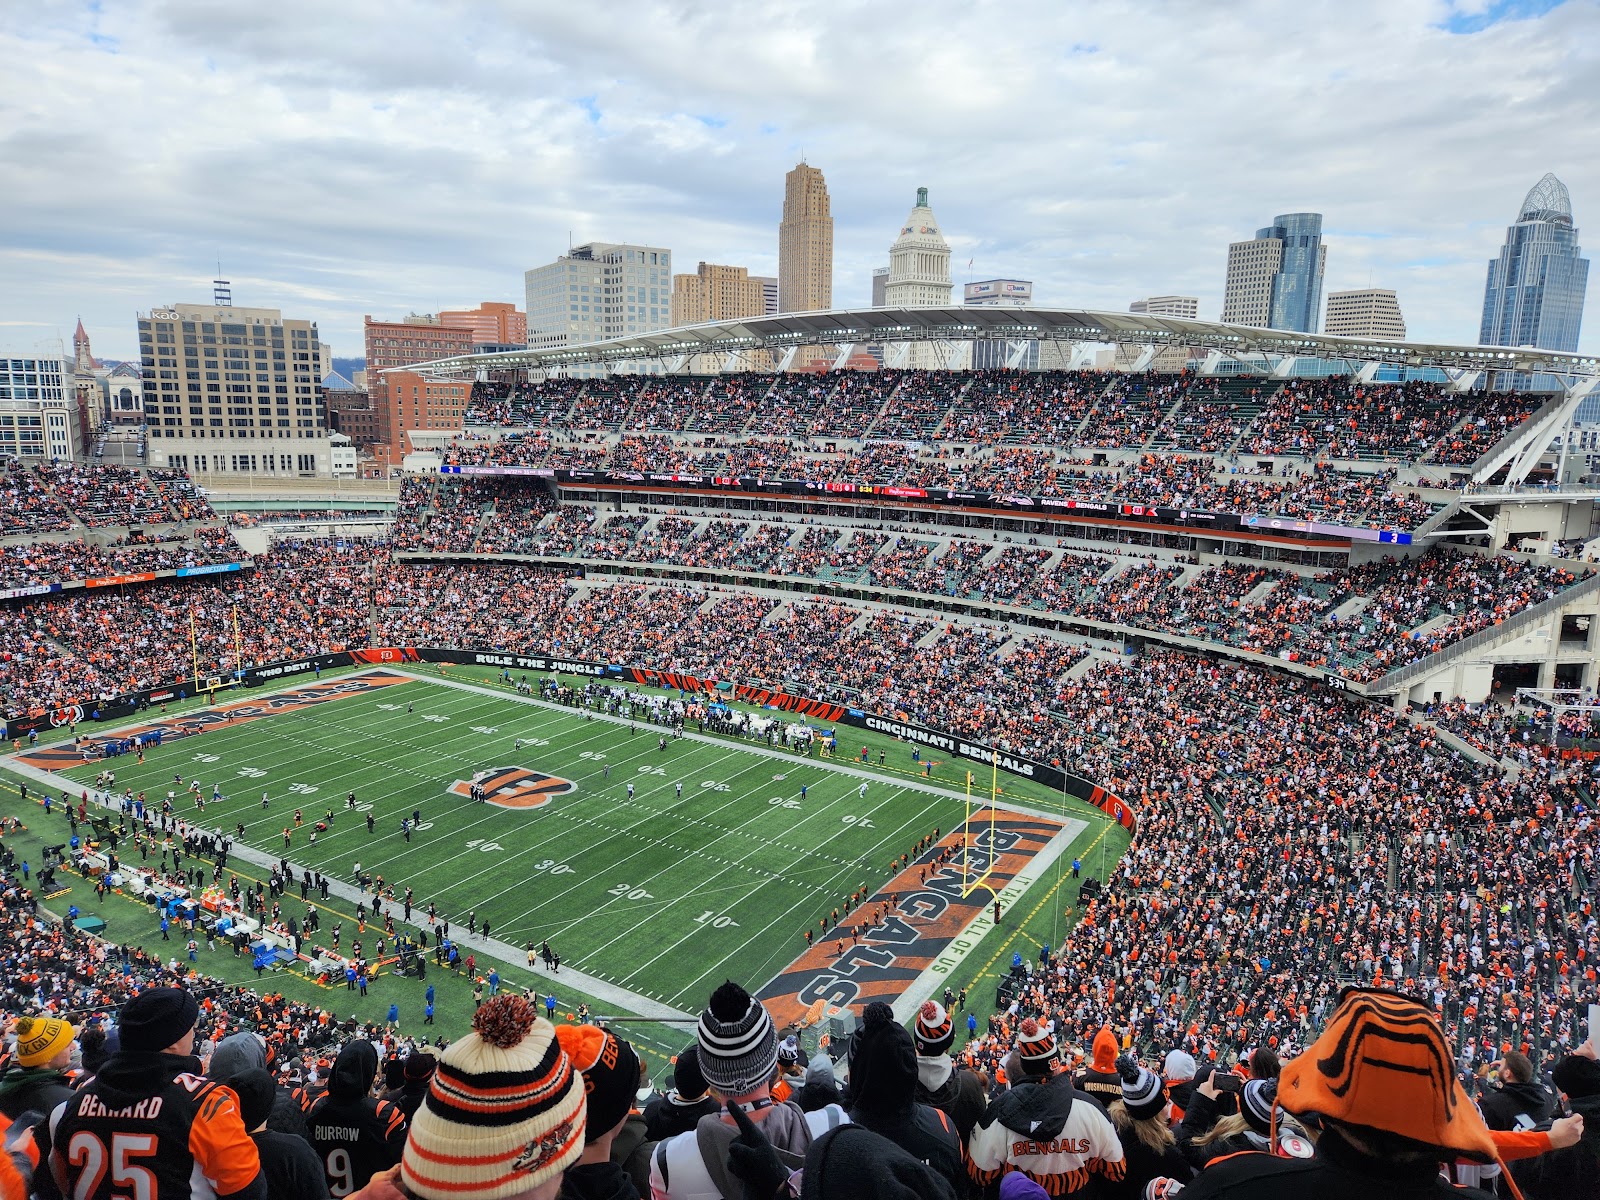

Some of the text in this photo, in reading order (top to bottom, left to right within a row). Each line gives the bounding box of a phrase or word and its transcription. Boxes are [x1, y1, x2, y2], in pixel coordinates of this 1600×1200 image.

[152, 312, 179, 320] kao
[1076, 502, 1107, 510] BENGALS
[1391, 534, 1398, 543] 3
[186, 565, 231, 575] PROGRESSIVE
[0, 585, 51, 599] BETFRED
[256, 669, 282, 678] WHO
[284, 662, 310, 673] DEY!
[476, 654, 513, 666] RULE
[517, 657, 546, 669] THE
[549, 661, 602, 675] JUNGLE
[866, 717, 1034, 776] CINCINNATI BENGALS
[466, 839, 499, 852] 40
[534, 860, 570, 874] 30
[1016, 875, 1032, 886] IT
[608, 884, 646, 900] 20
[694, 910, 732, 928] 10
[798, 828, 1023, 1009] BENGALS
[964, 918, 991, 935] ALL
[951, 940, 971, 956] OF
[932, 958, 957, 973] US
[32, 1038, 48, 1050] GO
[315, 1125, 359, 1142] BURROW
[1012, 1138, 1090, 1157] BENGALS
[68, 1130, 159, 1200] 25
[327, 1148, 354, 1197] 9
